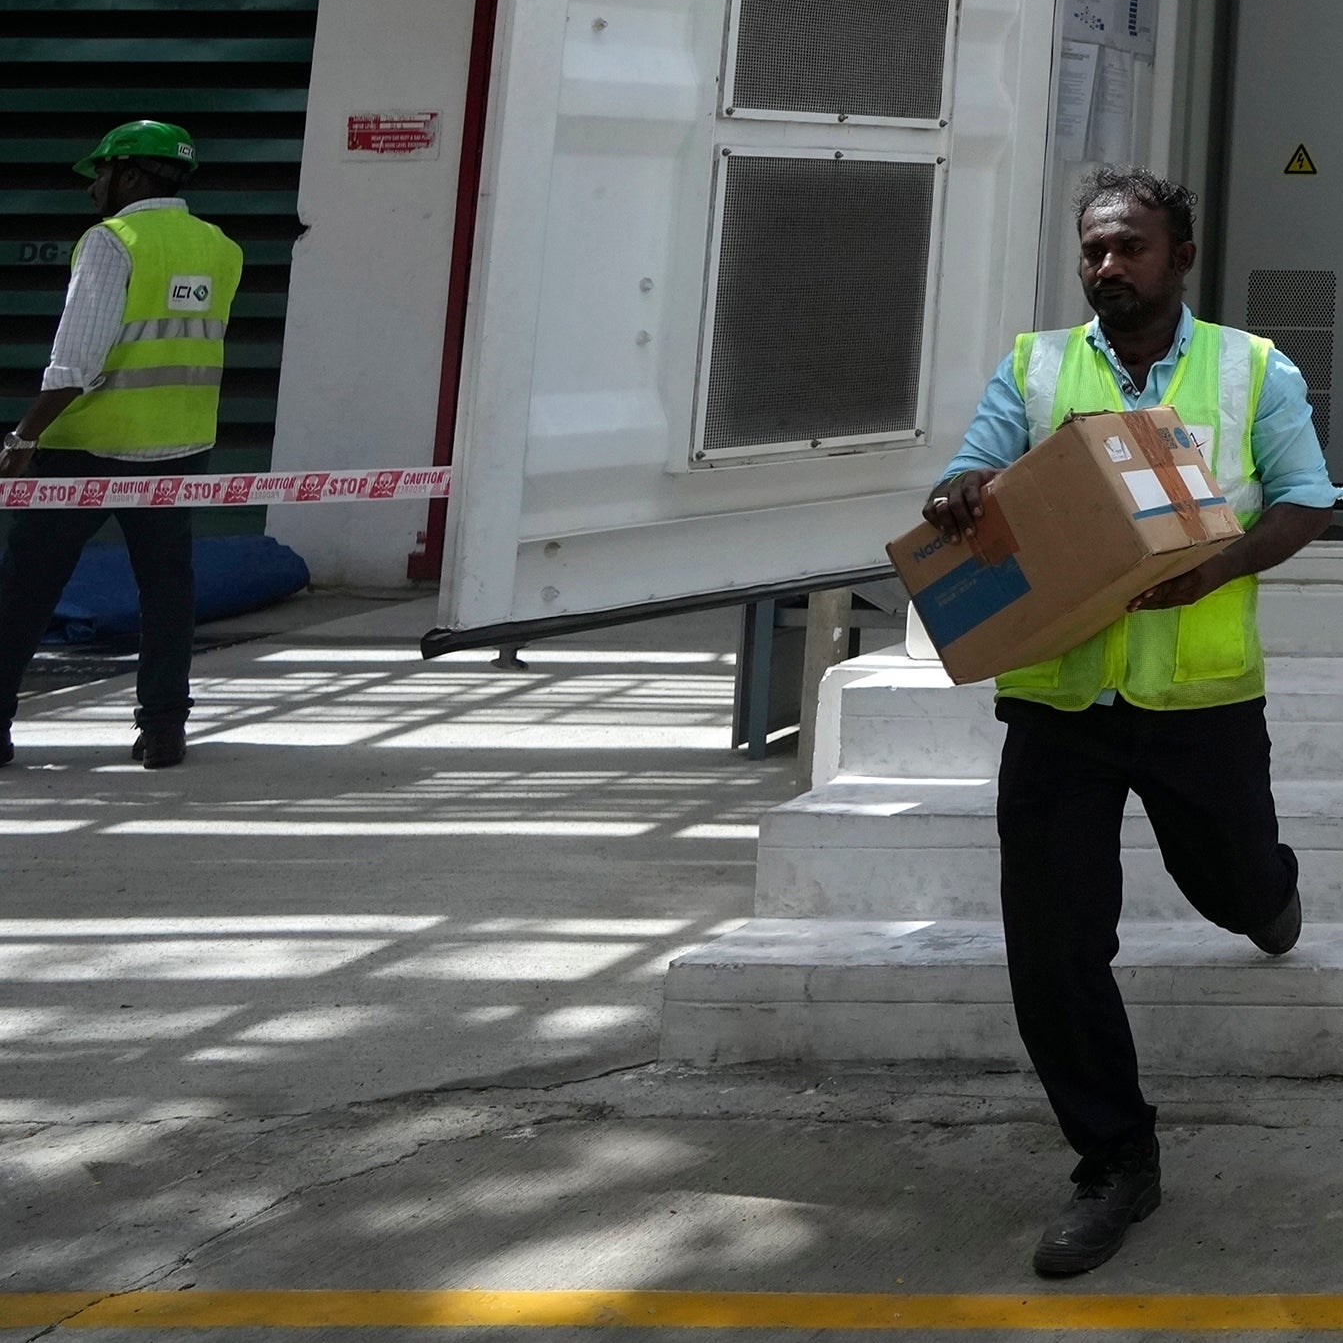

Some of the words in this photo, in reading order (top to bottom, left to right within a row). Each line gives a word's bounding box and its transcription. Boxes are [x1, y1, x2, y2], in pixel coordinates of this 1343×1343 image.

[38, 485, 76, 503] STOP
[112, 480, 150, 494] CAUTION
[183, 482, 221, 499] STOP
[256, 476, 295, 490] CAUTION
[328, 477, 367, 495] STOP
[403, 471, 443, 485] CAUTION
